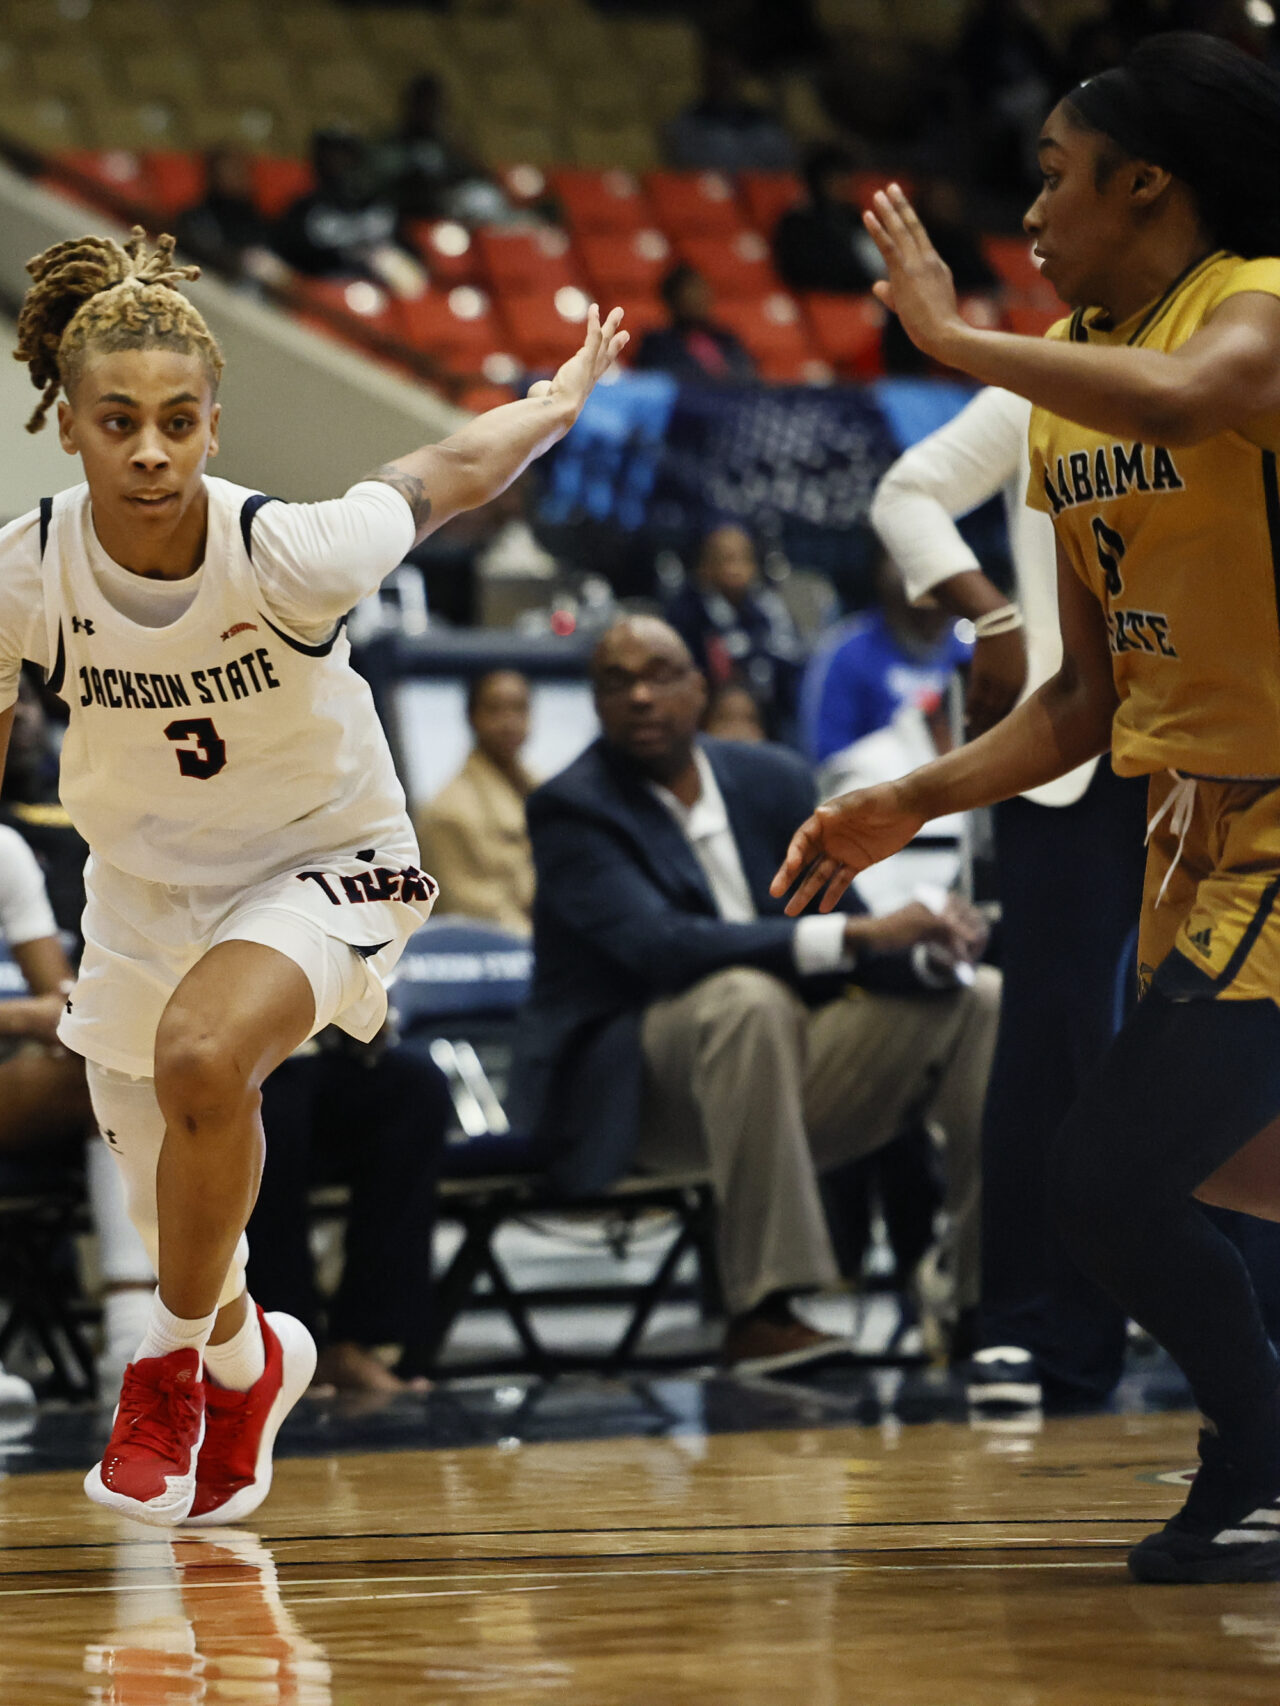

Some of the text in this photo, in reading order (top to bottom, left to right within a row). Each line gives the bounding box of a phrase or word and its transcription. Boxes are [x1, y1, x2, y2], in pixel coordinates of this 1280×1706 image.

[79, 647, 281, 709] JACKSON STATE
[163, 717, 228, 781] 3
